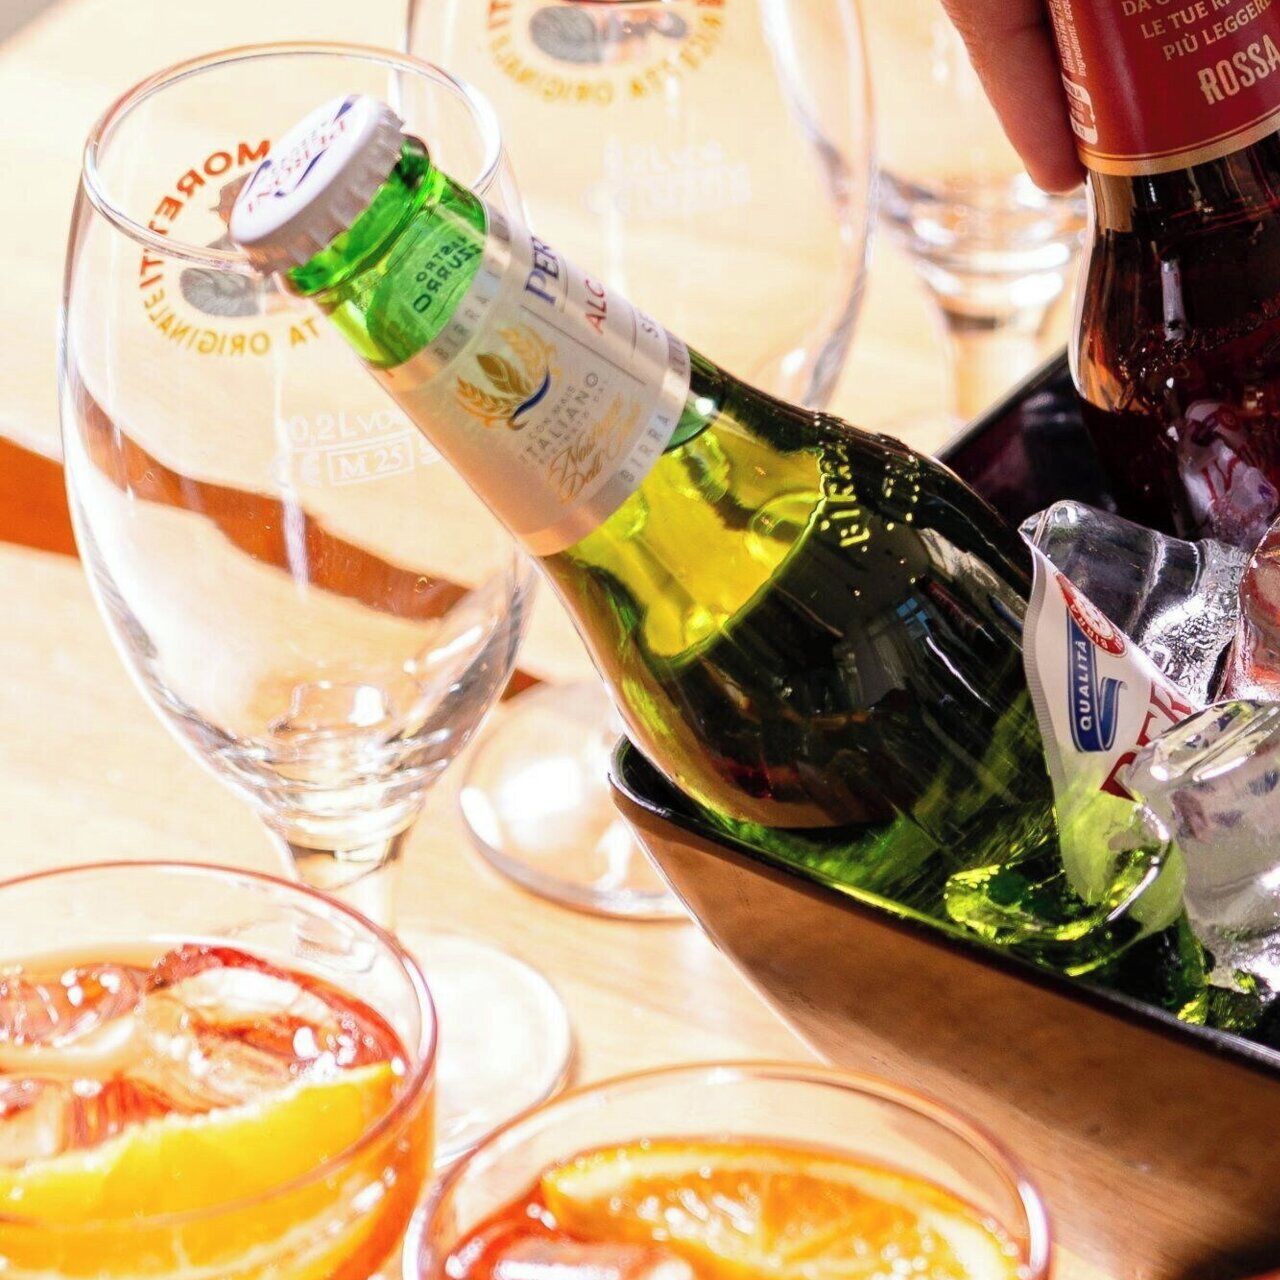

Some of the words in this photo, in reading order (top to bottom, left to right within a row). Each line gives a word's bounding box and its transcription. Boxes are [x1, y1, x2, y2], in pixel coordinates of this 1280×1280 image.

[1120, 0, 1153, 18] DA
[1139, 17, 1167, 40] LE
[1167, 0, 1210, 31] TUE
[1161, 32, 1200, 62] PIÙ
[618, 412, 672, 483] BIRRA
[1077, 639, 1093, 733] QUALITÀ
